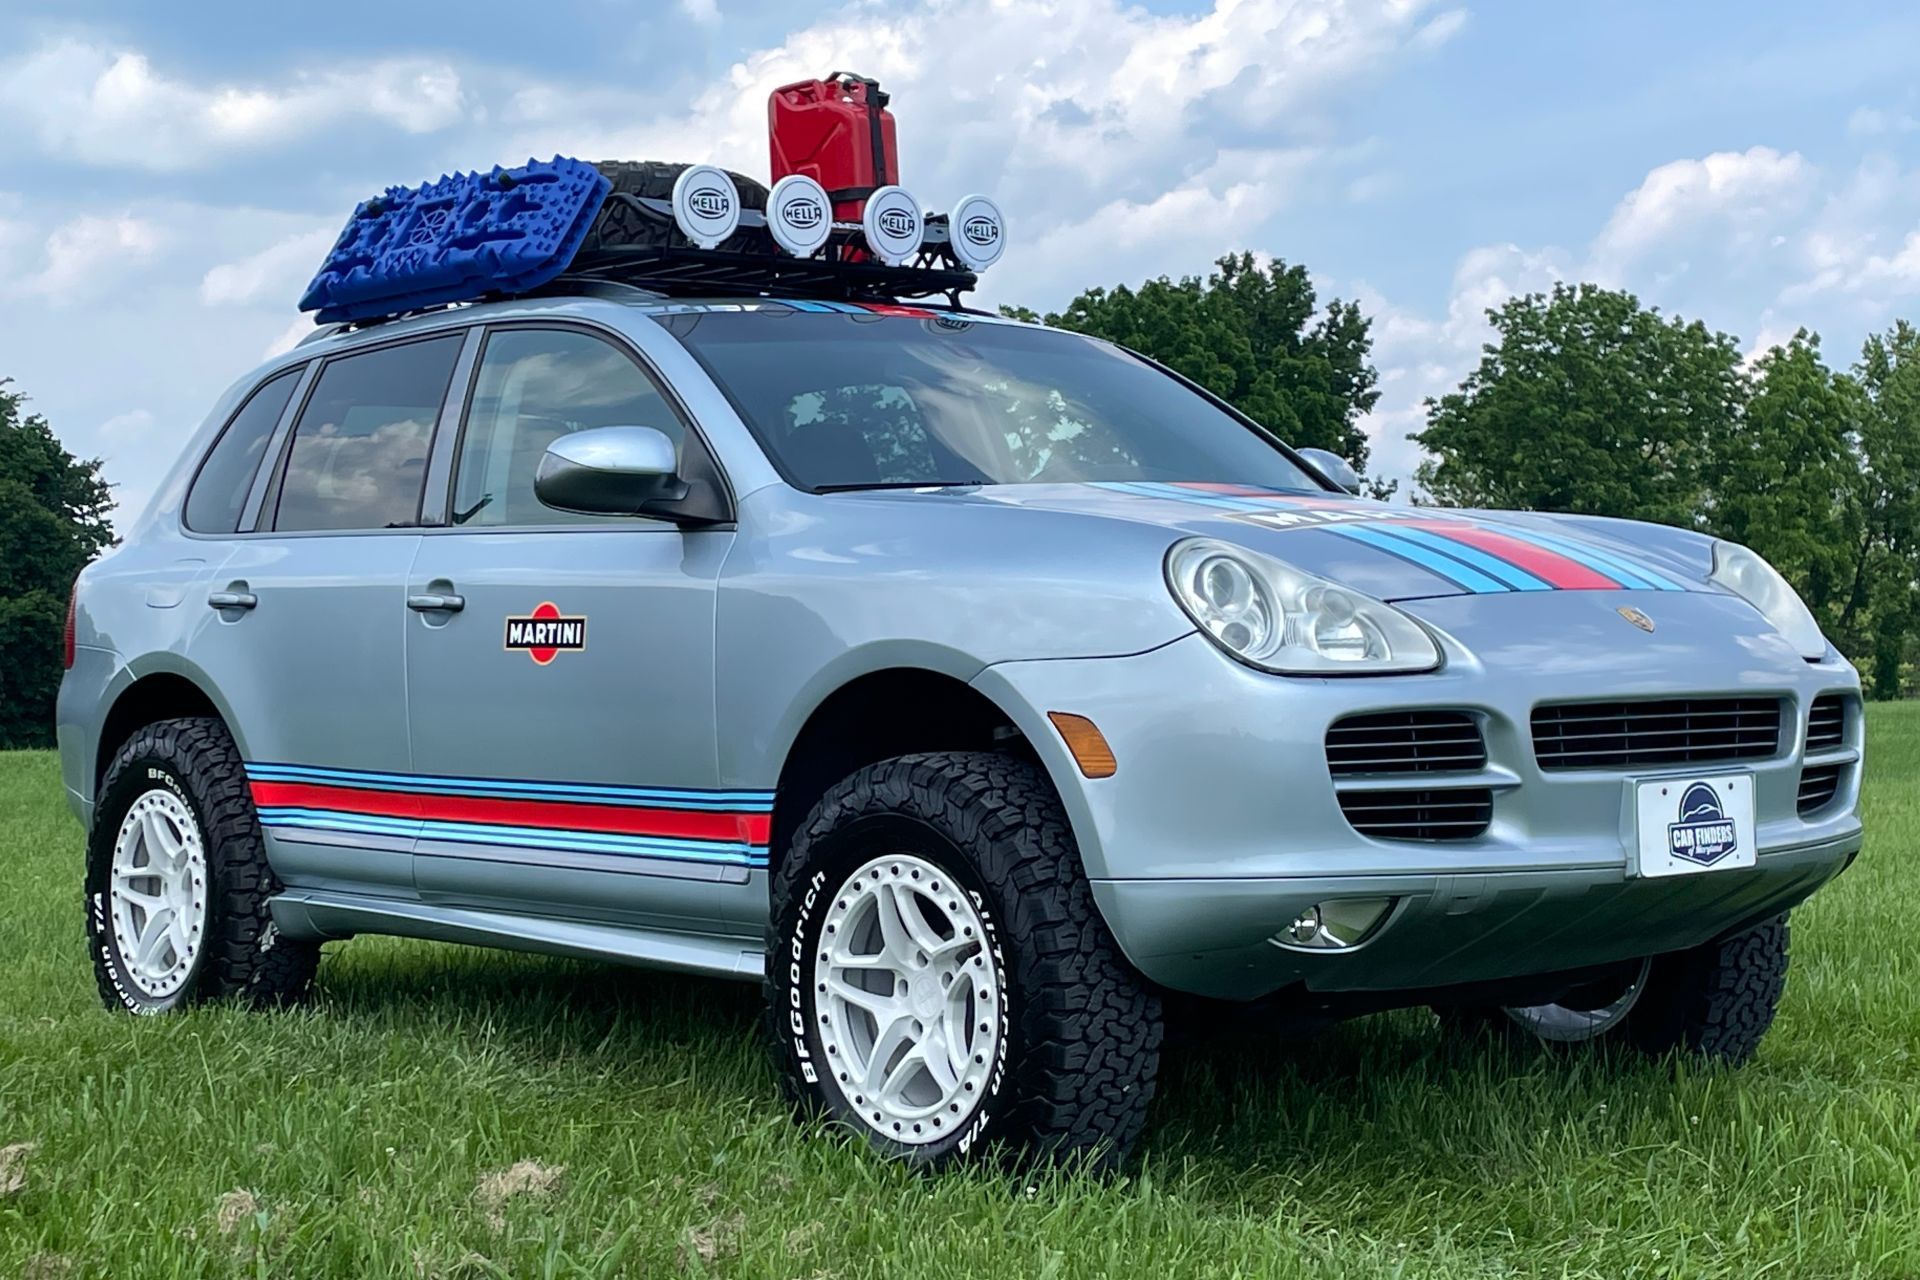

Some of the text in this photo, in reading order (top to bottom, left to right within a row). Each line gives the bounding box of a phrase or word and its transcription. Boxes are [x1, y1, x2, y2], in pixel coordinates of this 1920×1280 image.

[692, 197, 729, 213] HELLA
[785, 206, 822, 221] HELLA
[881, 216, 916, 233] HELLA
[966, 225, 999, 239] HELLA
[509, 622, 582, 644] MARTINI
[1673, 825, 1733, 848] CAR FINDERS
[790, 870, 827, 1084] BFGoodrich
